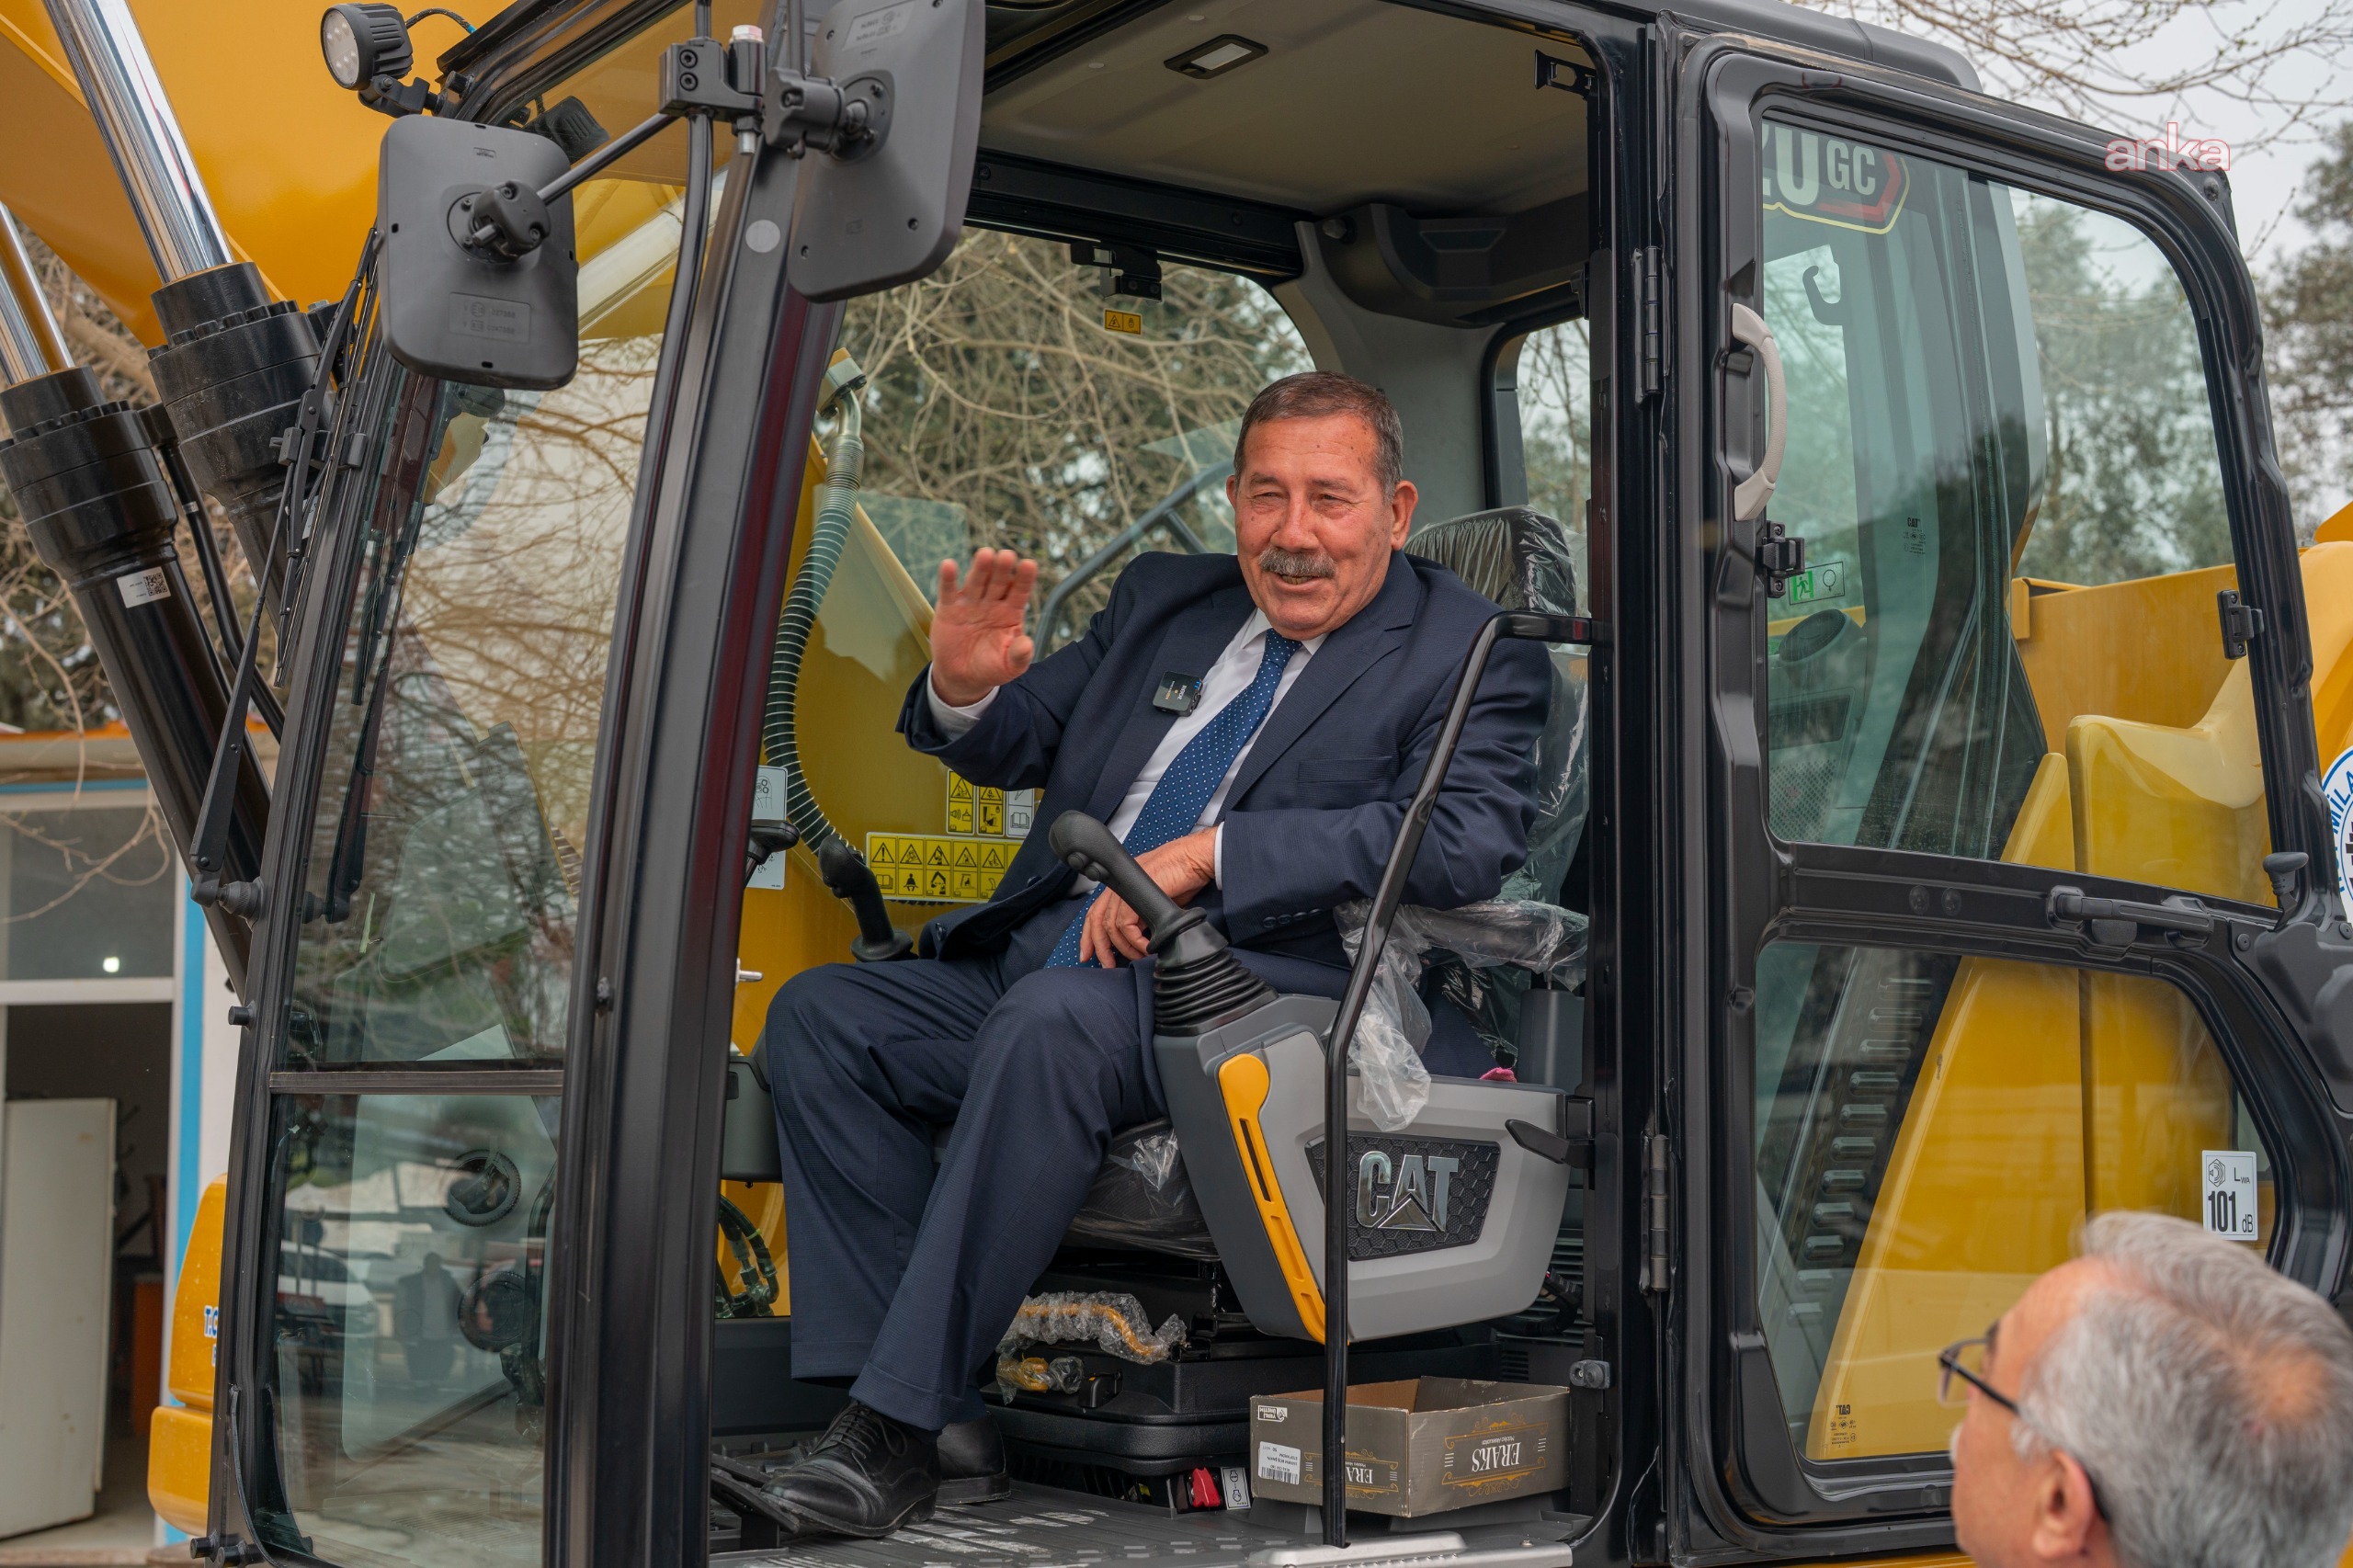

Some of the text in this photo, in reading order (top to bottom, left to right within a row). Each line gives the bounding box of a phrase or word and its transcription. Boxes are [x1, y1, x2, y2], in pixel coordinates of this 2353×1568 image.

[1826, 140, 1876, 196] GC
[1357, 1151, 1459, 1232] CAT
[2208, 1190, 2254, 1233] 101 dB
[1346, 1466, 1374, 1484] ERA
[1472, 1442, 1521, 1472] ERAKS
